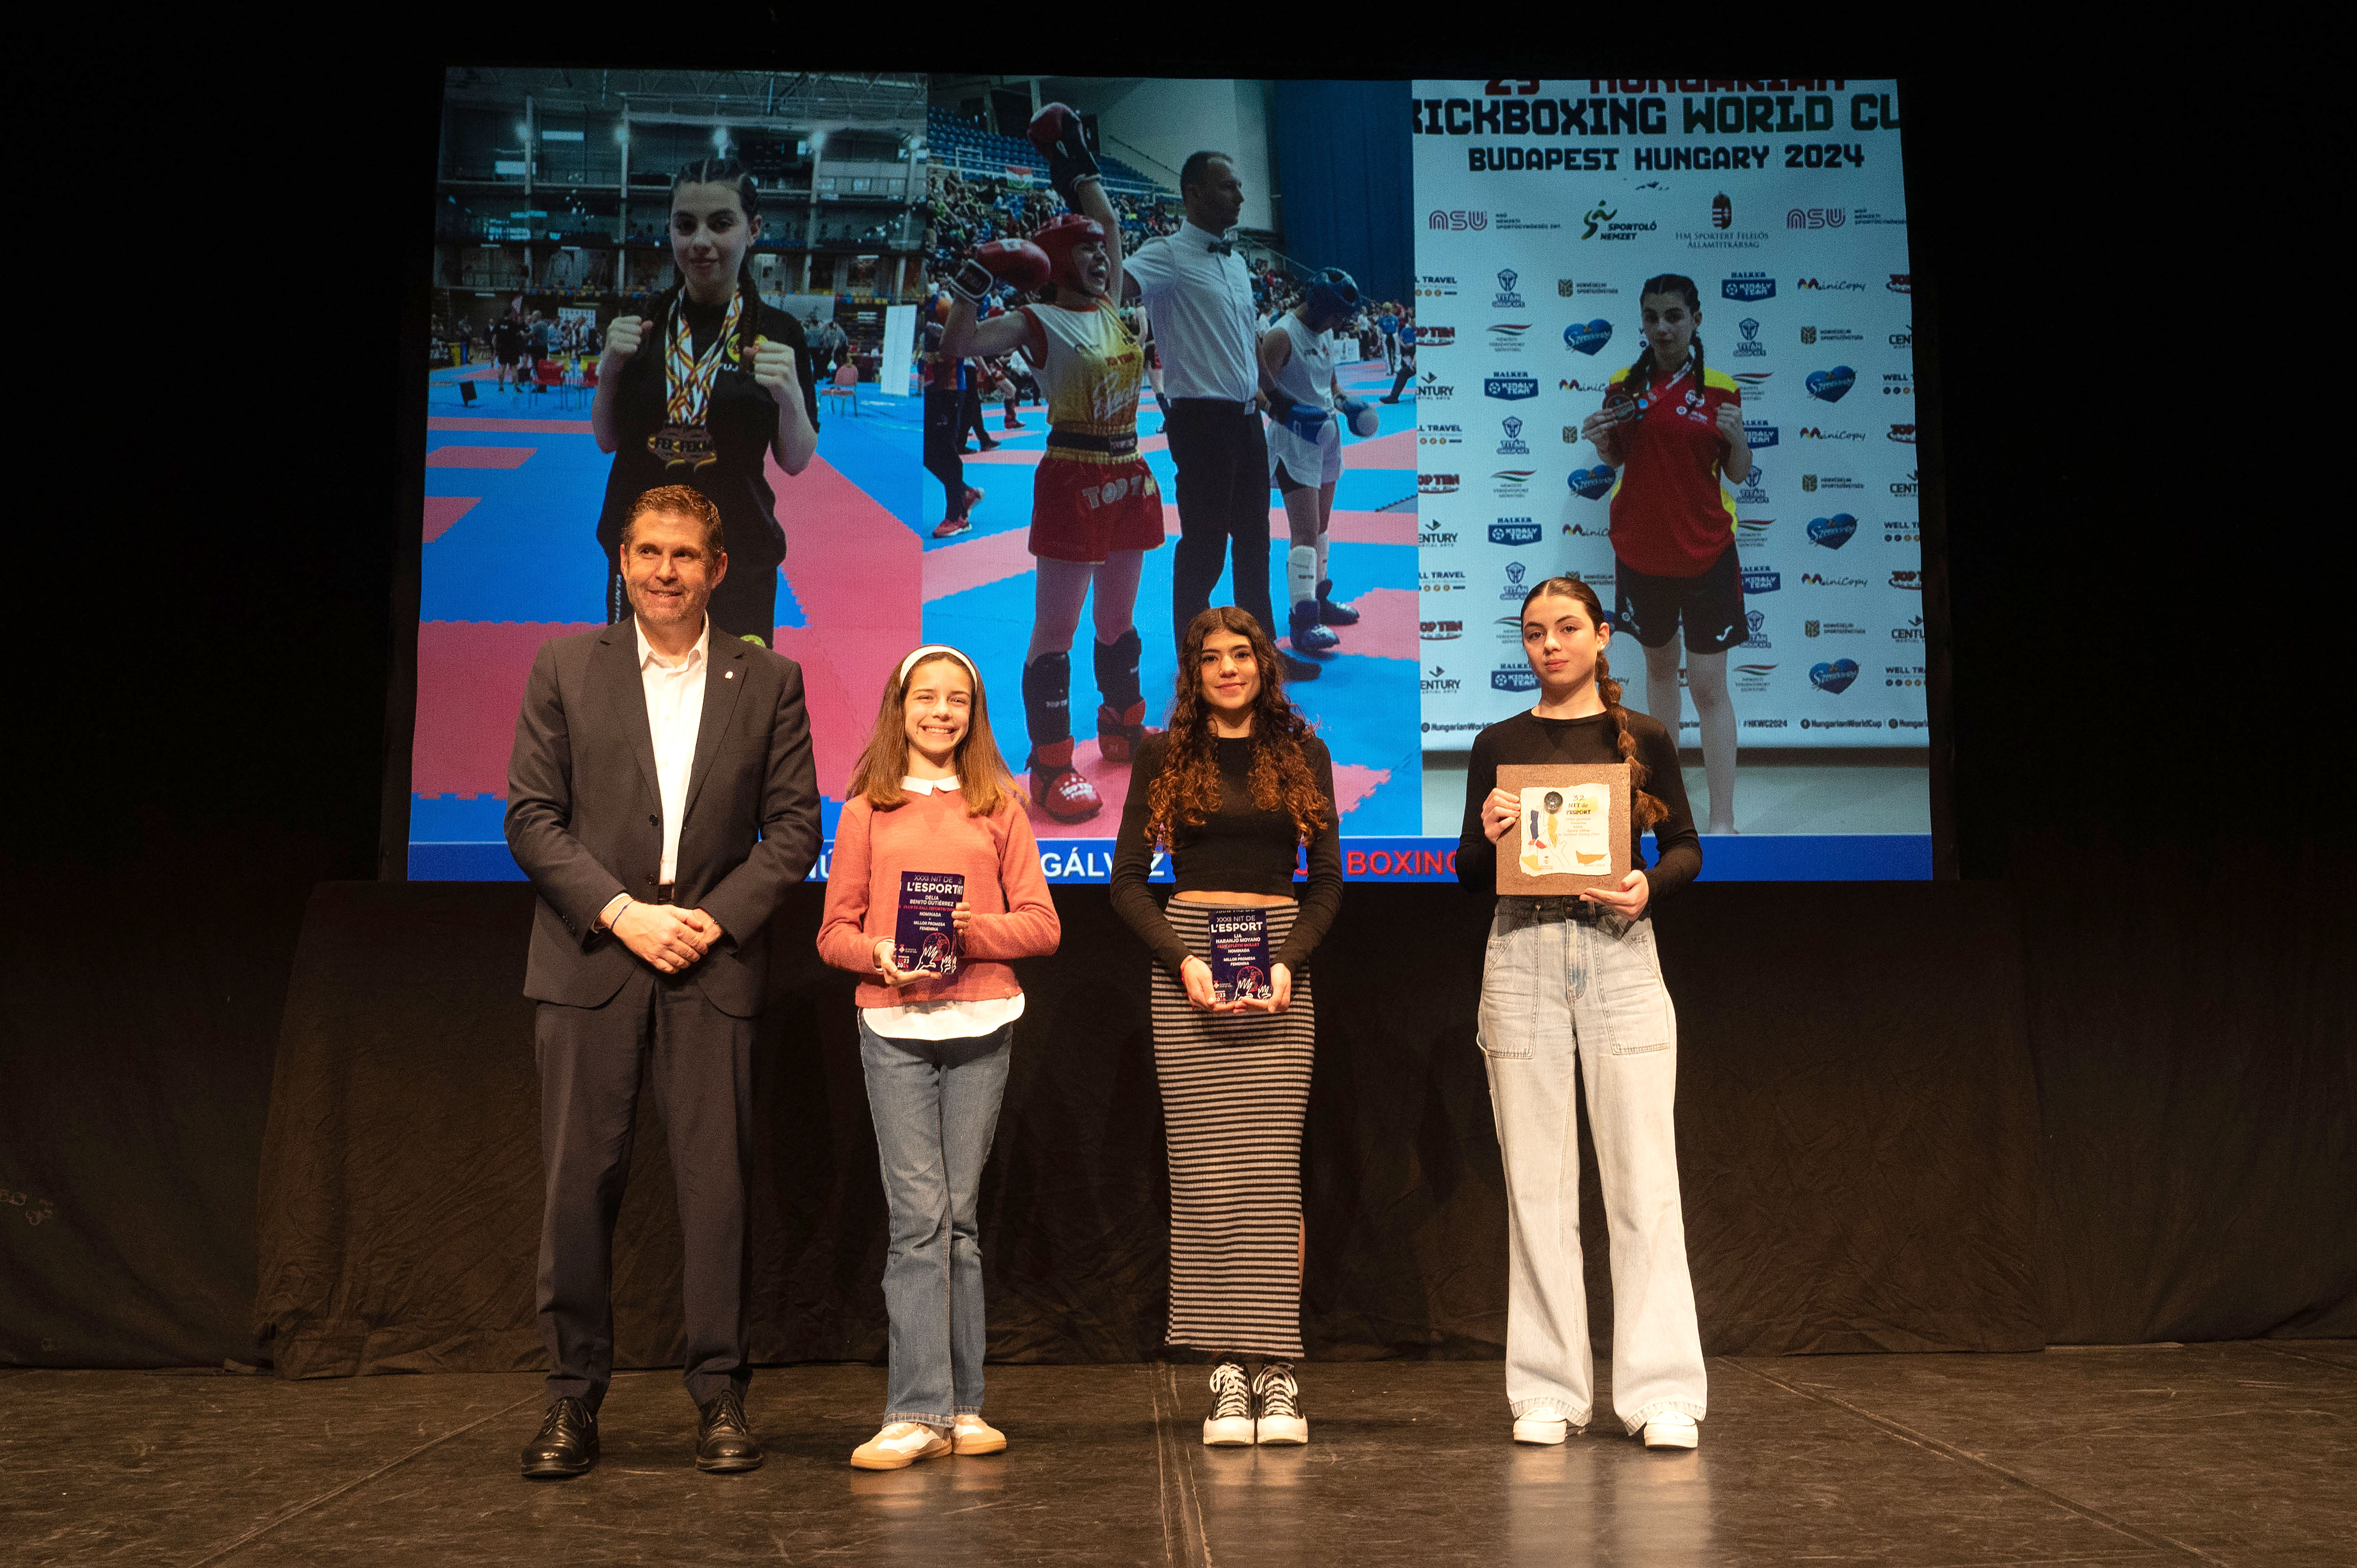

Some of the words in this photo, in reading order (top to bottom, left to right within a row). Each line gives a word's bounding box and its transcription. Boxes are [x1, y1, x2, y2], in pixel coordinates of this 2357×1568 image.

[1684, 96, 1833, 134] WORLD
[1468, 148, 1619, 171] BUDAPEST
[1634, 145, 1769, 170] HUNGARY
[1785, 144, 1865, 168] 2024
[1434, 474, 1460, 485] TEN
[1082, 478, 1128, 509] TOP
[1436, 620, 1462, 633] TEN
[906, 881, 957, 894] L'ESPORT
[1211, 922, 1263, 933] L'ESPORT
